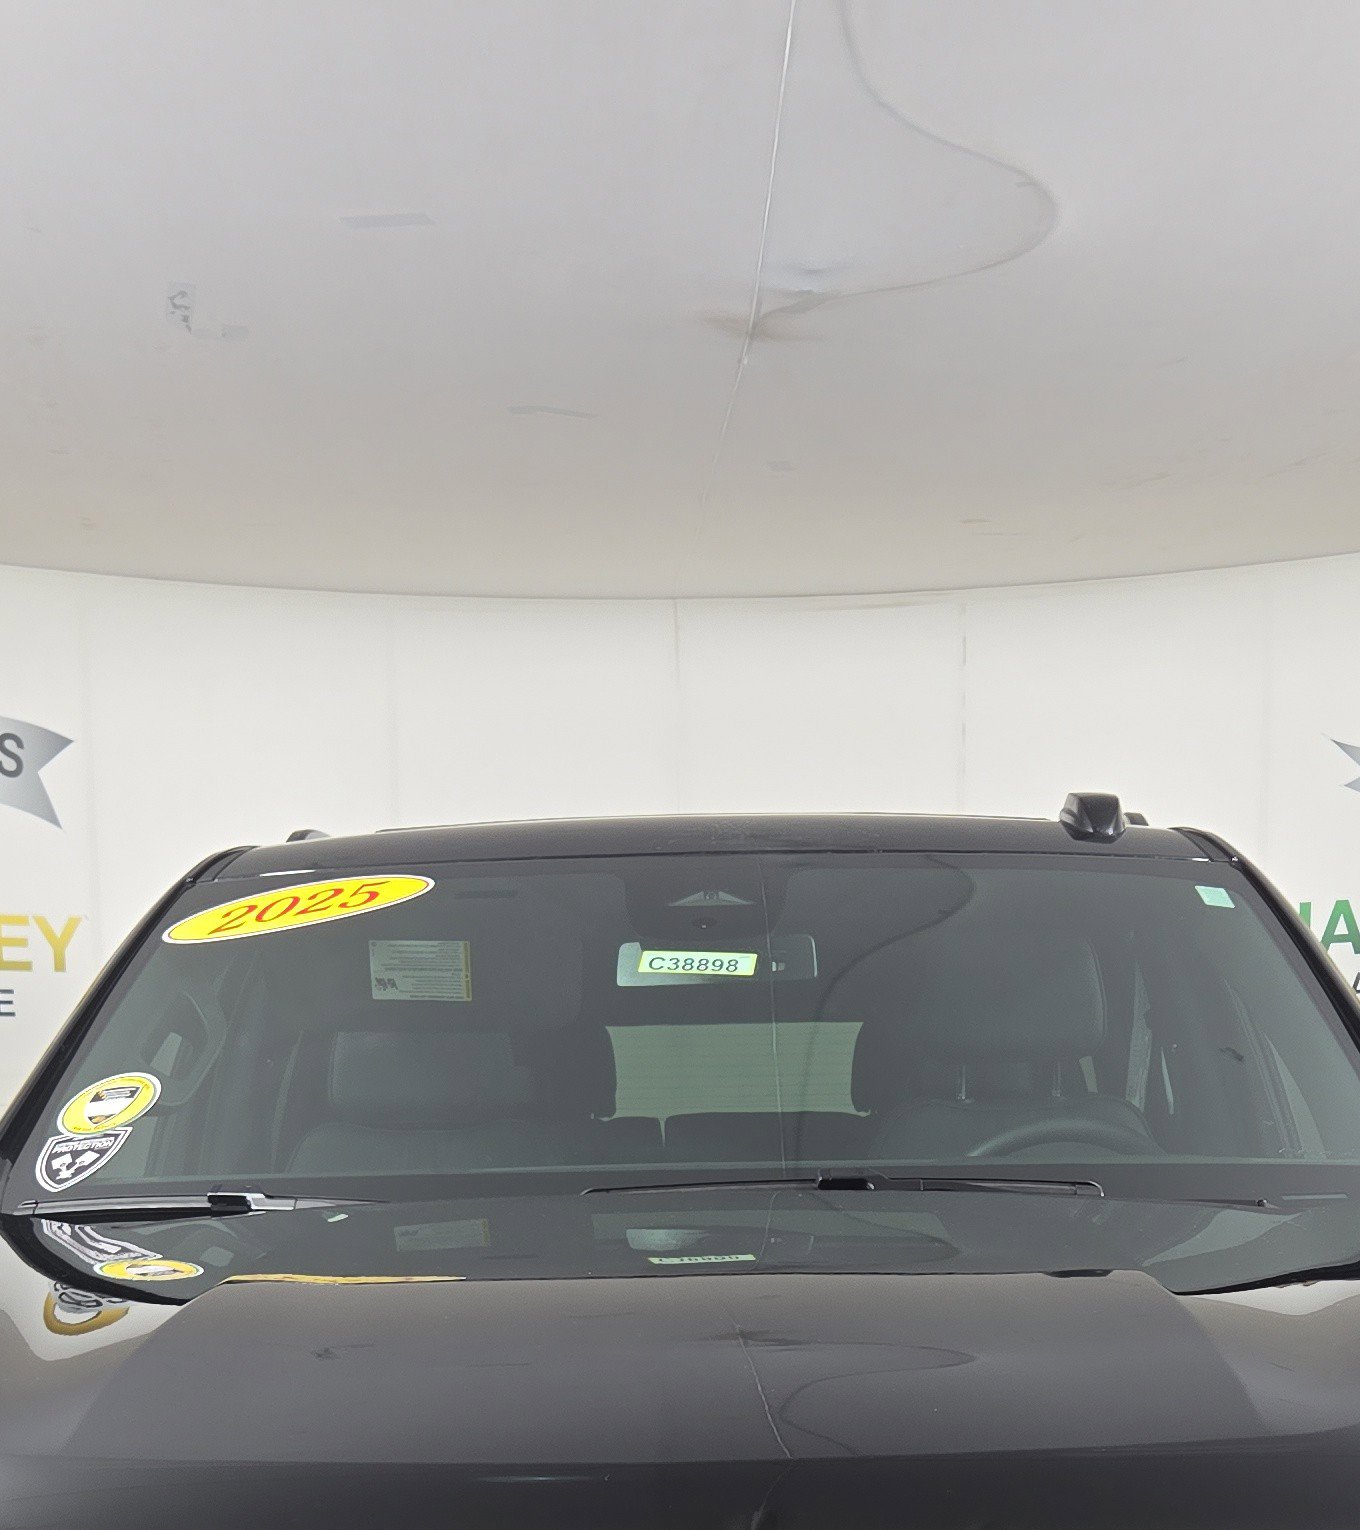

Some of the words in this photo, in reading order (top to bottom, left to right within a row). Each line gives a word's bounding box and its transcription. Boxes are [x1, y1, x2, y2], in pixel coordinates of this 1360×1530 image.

[207, 881, 390, 935] 2025
[648, 957, 739, 972] C38898
[52, 1139, 114, 1153] PROTECTION
